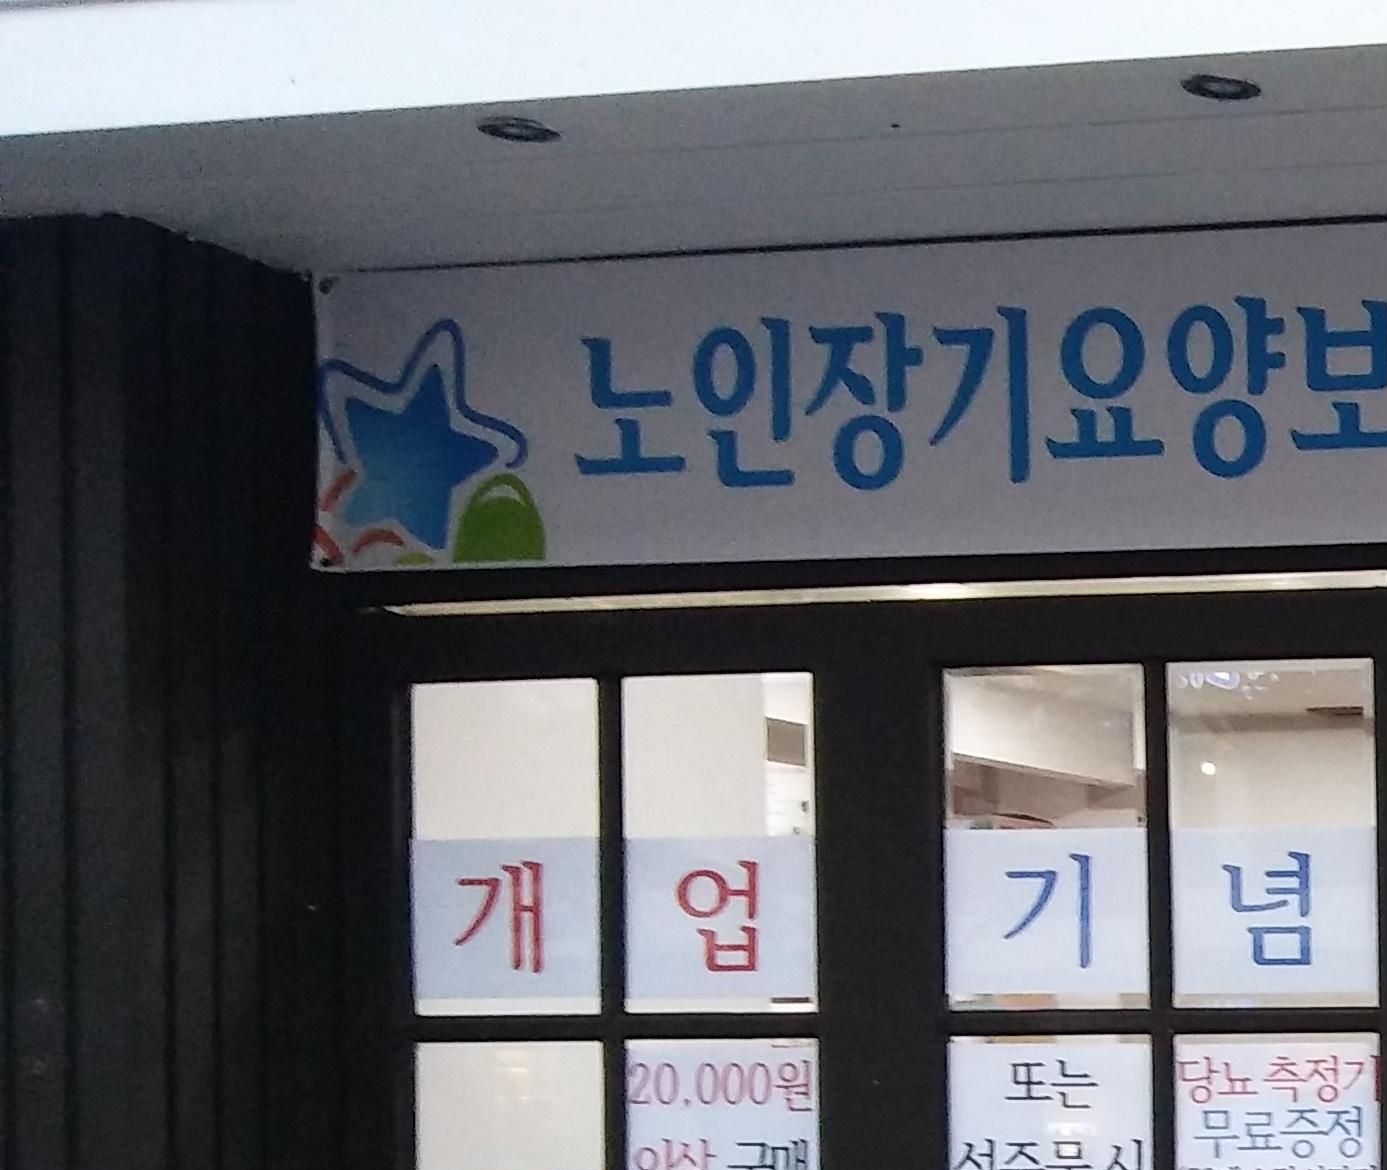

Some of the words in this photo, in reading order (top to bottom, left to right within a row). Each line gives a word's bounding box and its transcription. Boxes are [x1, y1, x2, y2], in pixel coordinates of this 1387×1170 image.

[453, 860, 546, 973] 개
[675, 859, 760, 973] 업
[1004, 853, 1093, 970] 기
[1224, 851, 1313, 968] 념
[1004, 1058, 1100, 1109] 또는
[1194, 1105, 1363, 1159] 무료증정
